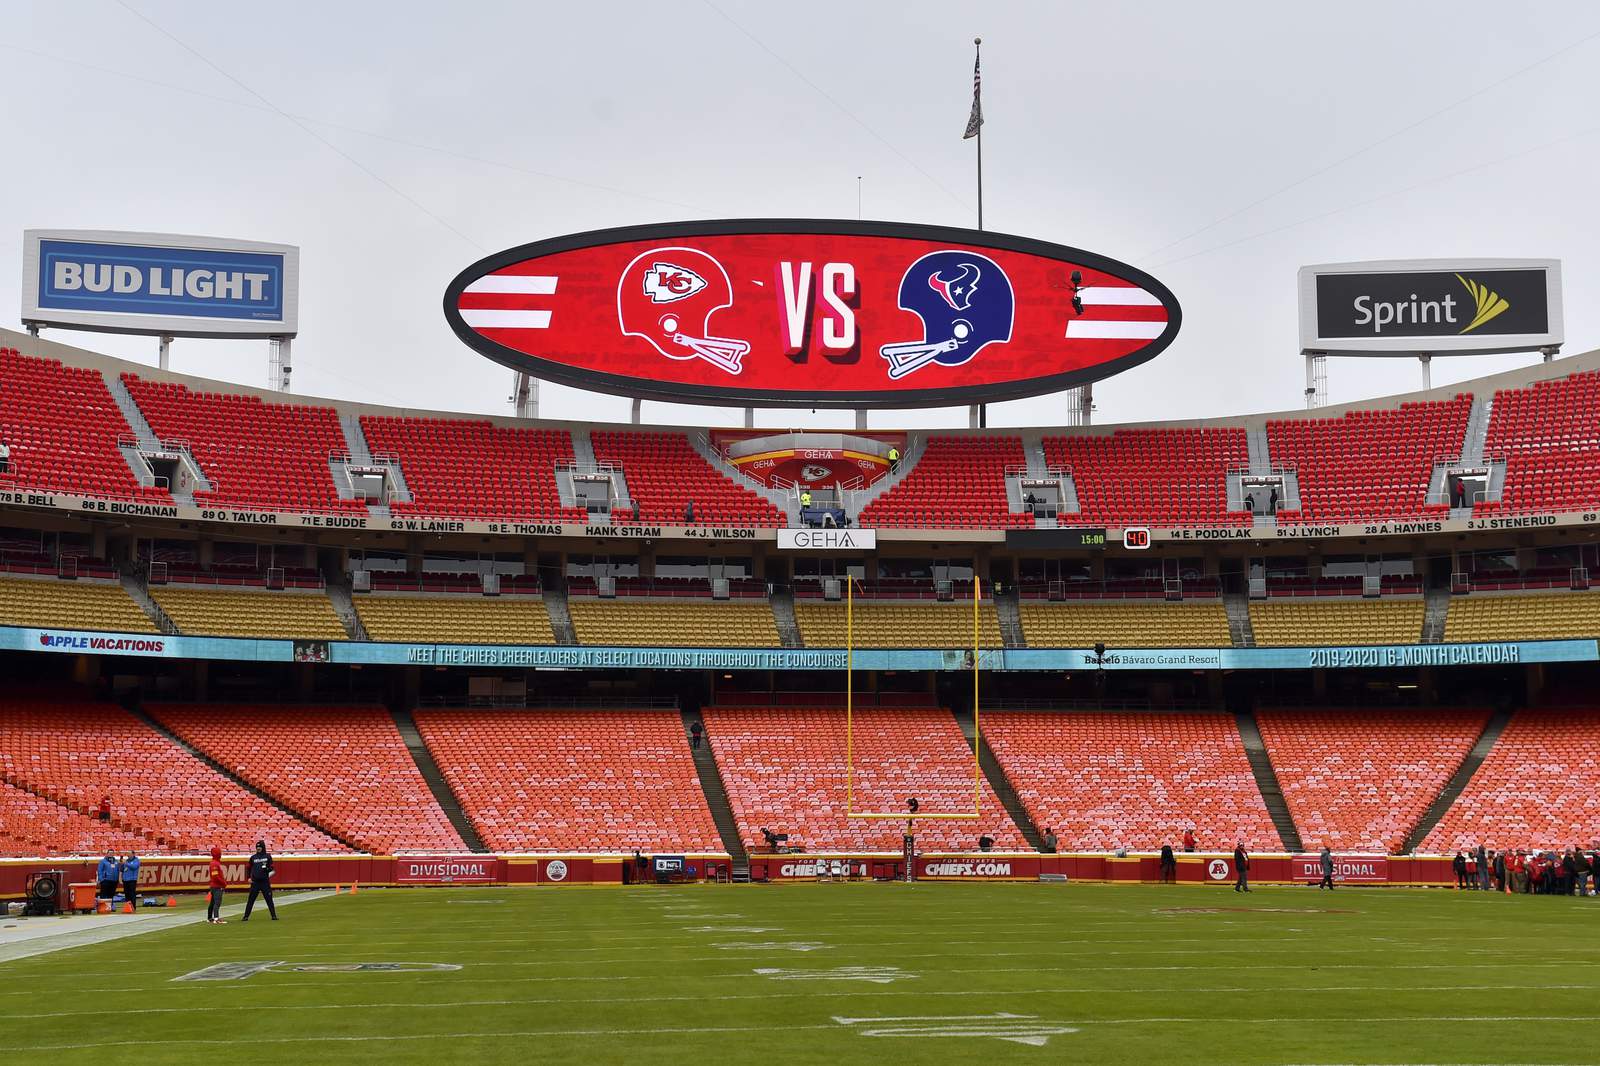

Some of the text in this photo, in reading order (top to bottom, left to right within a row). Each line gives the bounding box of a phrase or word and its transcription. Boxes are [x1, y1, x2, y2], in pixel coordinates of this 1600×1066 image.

[54, 261, 269, 301] BUD LIGHT
[776, 261, 856, 353] VS
[1353, 293, 1457, 333] Sprint
[804, 450, 833, 459] GEHA
[753, 459, 776, 469] GEHA
[857, 460, 876, 470] GEHA
[0, 492, 56, 507] 78 B. BELL
[82, 500, 177, 517] 86 B. BUCHANAN
[202, 510, 276, 524] 89 O. TAYLOR
[301, 516, 367, 528] 71 E. BUDDE
[1468, 515, 1556, 529] 3 J. STENERUD
[1583, 513, 1597, 521] 69
[391, 521, 464, 532] 63 W. LANIER
[488, 524, 562, 535] 18 E. THOMAS
[586, 526, 661, 537] HANK STRAM
[1277, 526, 1340, 537] 51 J. LYNCH
[1365, 522, 1442, 534] 28 A. HAYNES
[684, 529, 755, 538] 44 J. WILSON
[794, 531, 856, 547] GEHA
[1081, 534, 1104, 545] 15:00
[1127, 531, 1147, 545] 40
[1171, 529, 1252, 539] 14 E. PODOLAK
[46, 636, 163, 652] APPLE VACATIONS
[408, 647, 848, 668] MEET THE CHIEFS CHEERLEADERS AT SELECT LOCATIONS THROUGHOUT THE CONCOURSE
[1157, 655, 1186, 664] Grand
[1188, 655, 1218, 664] Resort
[1309, 645, 1519, 667] 2019-2020 16-MONTH CALENDAR
[410, 864, 486, 876] DIVISIONAL
[925, 864, 1011, 876] CHIEFS.COM
[1304, 863, 1376, 875] DIVSIONAL
